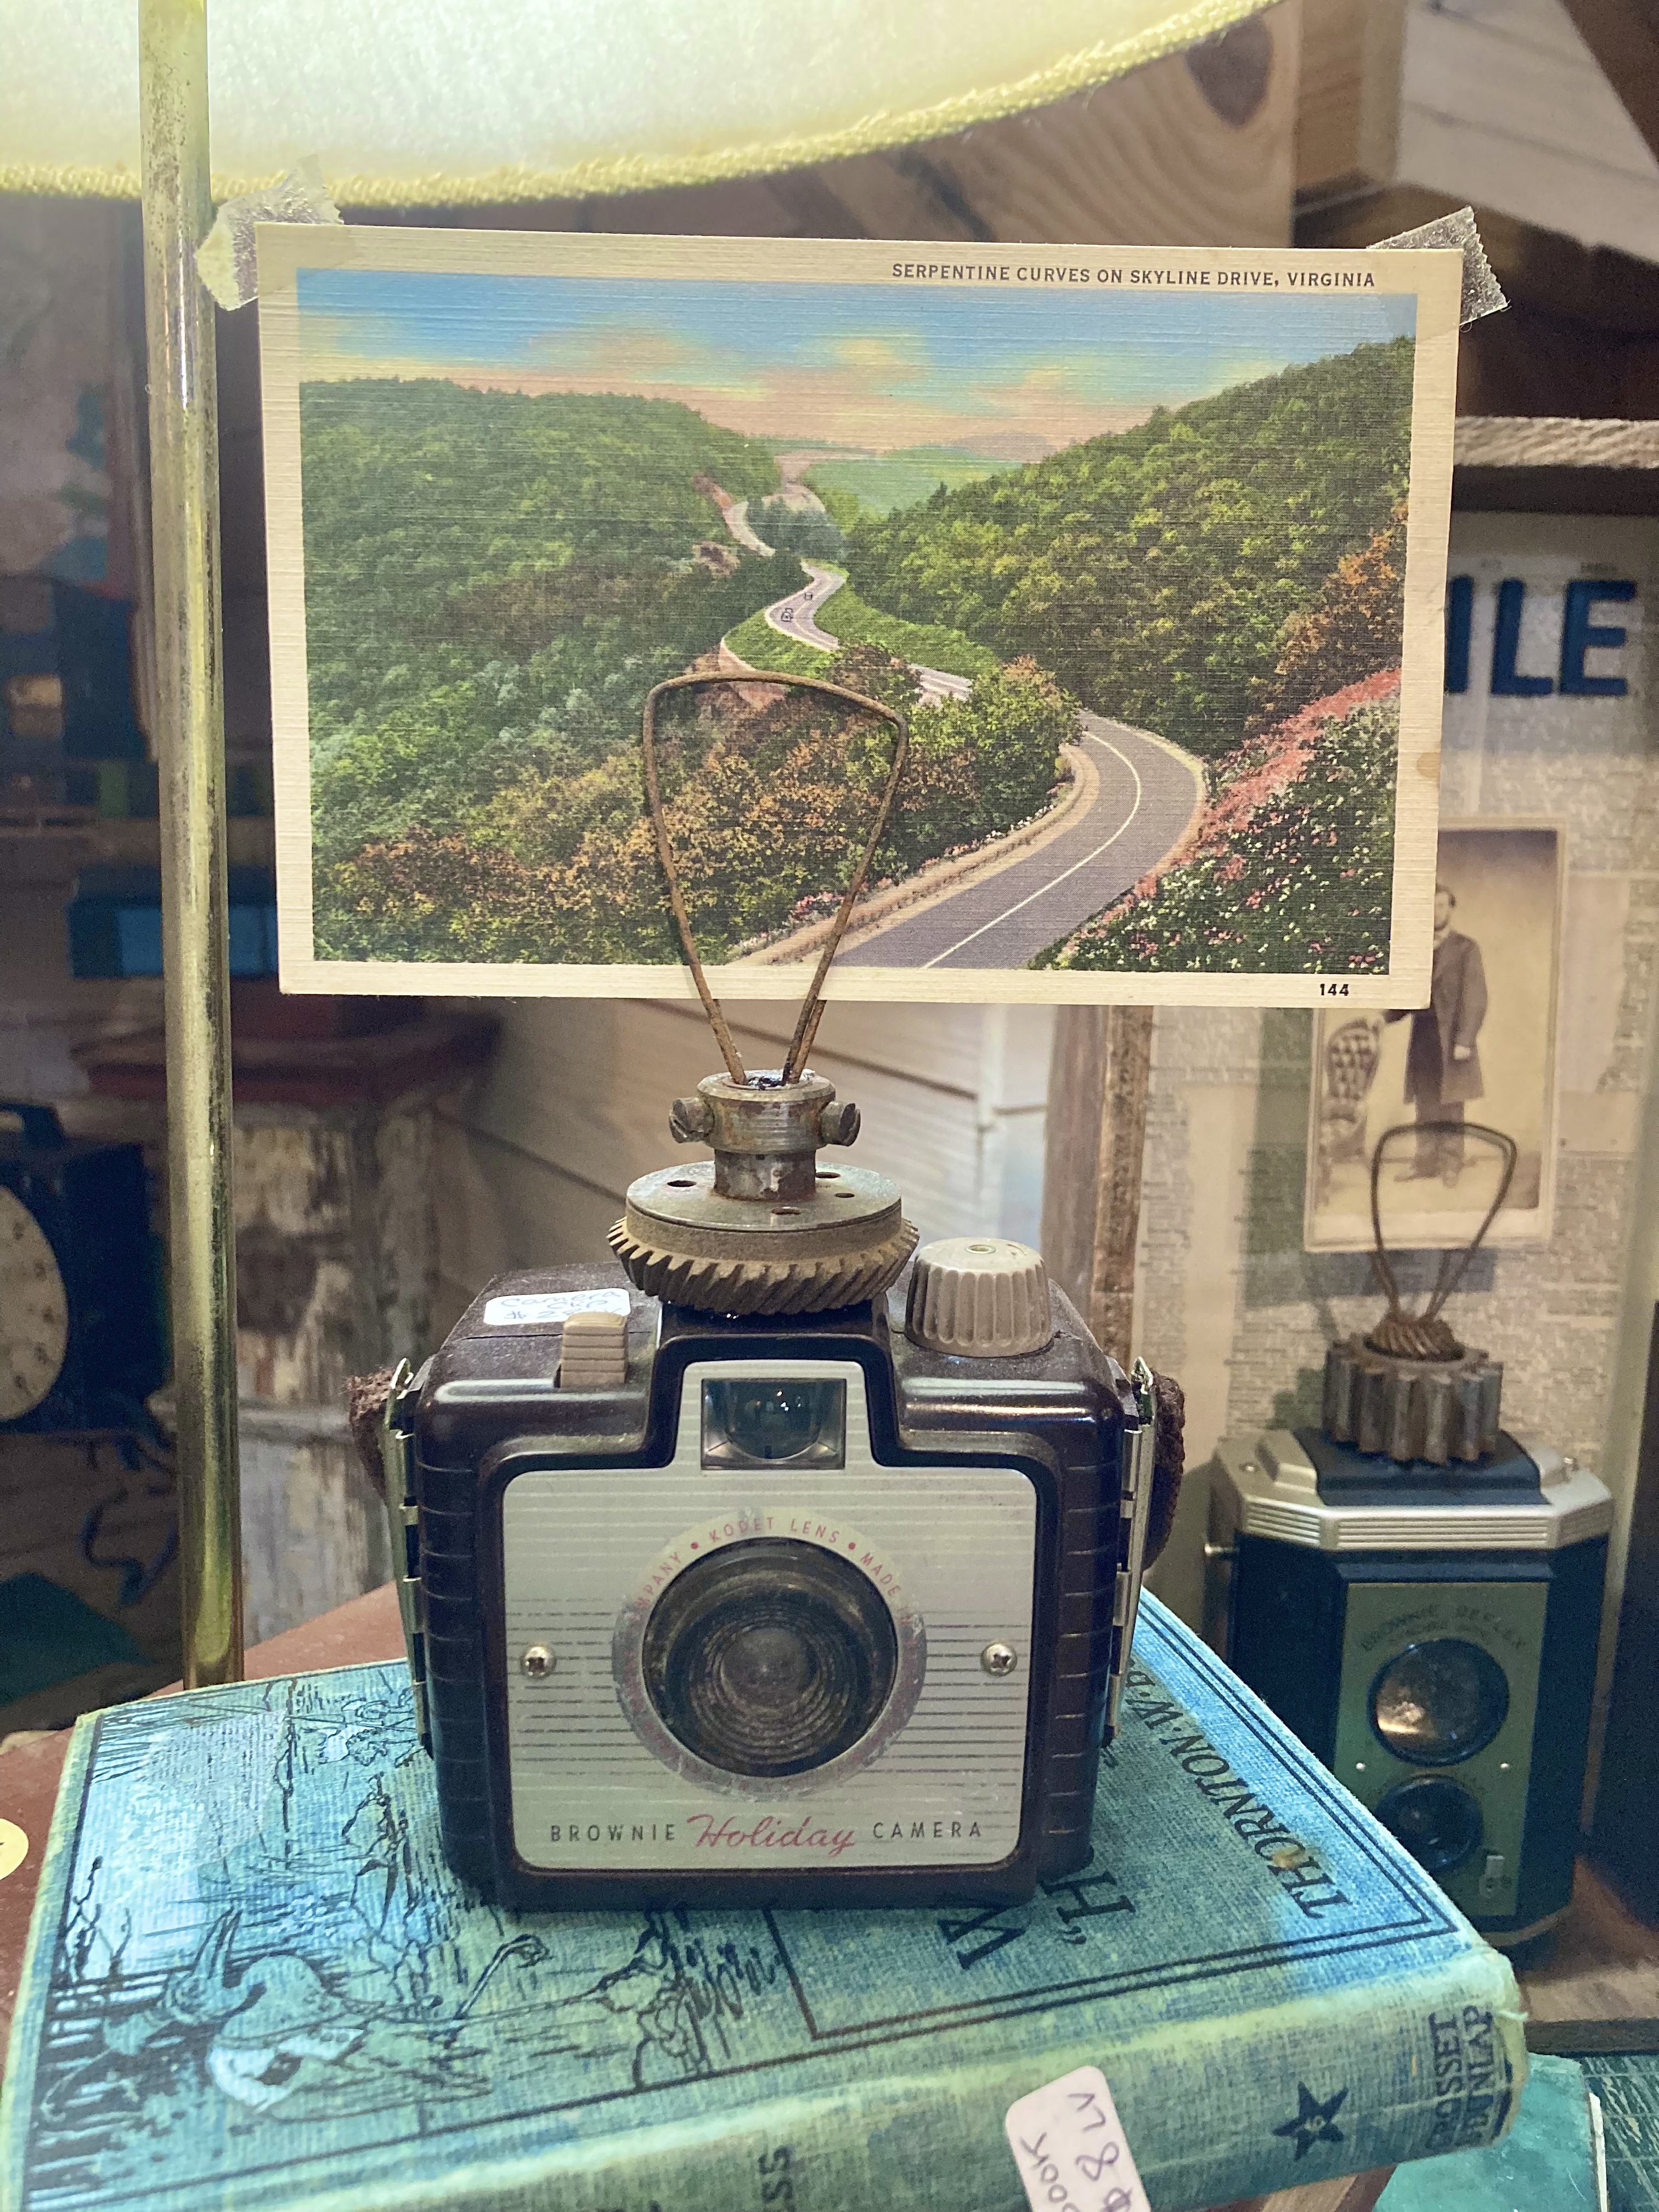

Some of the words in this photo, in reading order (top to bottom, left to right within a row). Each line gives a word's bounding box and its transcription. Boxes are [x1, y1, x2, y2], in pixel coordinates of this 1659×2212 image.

[892, 263, 1011, 282] SERPENTINE
[1016, 267, 1090, 284] CURVES
[1097, 268, 1122, 284] ON
[1129, 269, 1211, 286] SKYLINE
[1217, 270, 1280, 288] DRIVE,
[1287, 272, 1376, 288] VIRGINIA
[1319, 983, 1350, 996] 144
[708, 1516, 774, 1543] KODET
[790, 1518, 840, 1544] LENS
[859, 1551, 902, 1597] MADE
[550, 1823, 676, 1843] BROWNIE
[686, 1814, 855, 1858] Holiday
[873, 1820, 983, 1839] CAMERA
